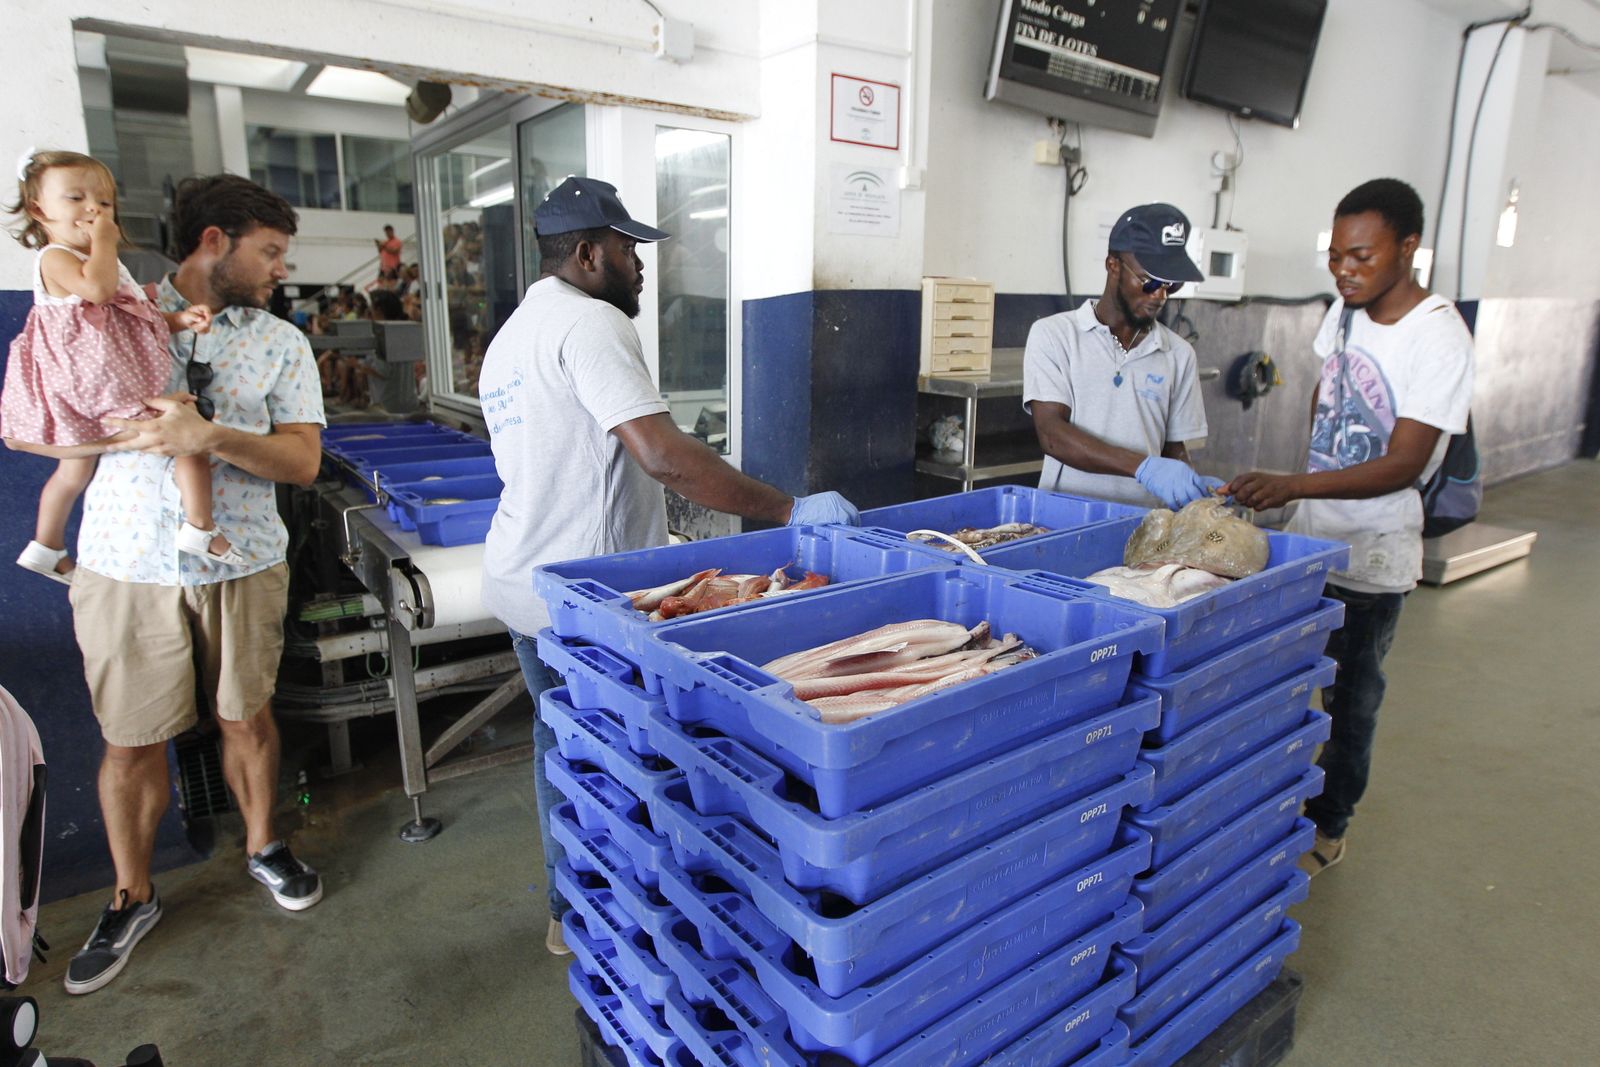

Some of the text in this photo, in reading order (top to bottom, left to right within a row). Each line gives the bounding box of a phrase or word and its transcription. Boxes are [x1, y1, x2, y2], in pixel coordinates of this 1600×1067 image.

[1052, 4, 1086, 29] Carga
[1015, 21, 1099, 57] FIN DE LOTES
[1090, 644, 1118, 663] OPP71
[1085, 724, 1113, 745] OPP71
[1080, 803, 1107, 824] OPP71
[1076, 871, 1103, 893] OPP71
[1070, 944, 1097, 967] OPP71
[1065, 1010, 1091, 1033] OPP71
